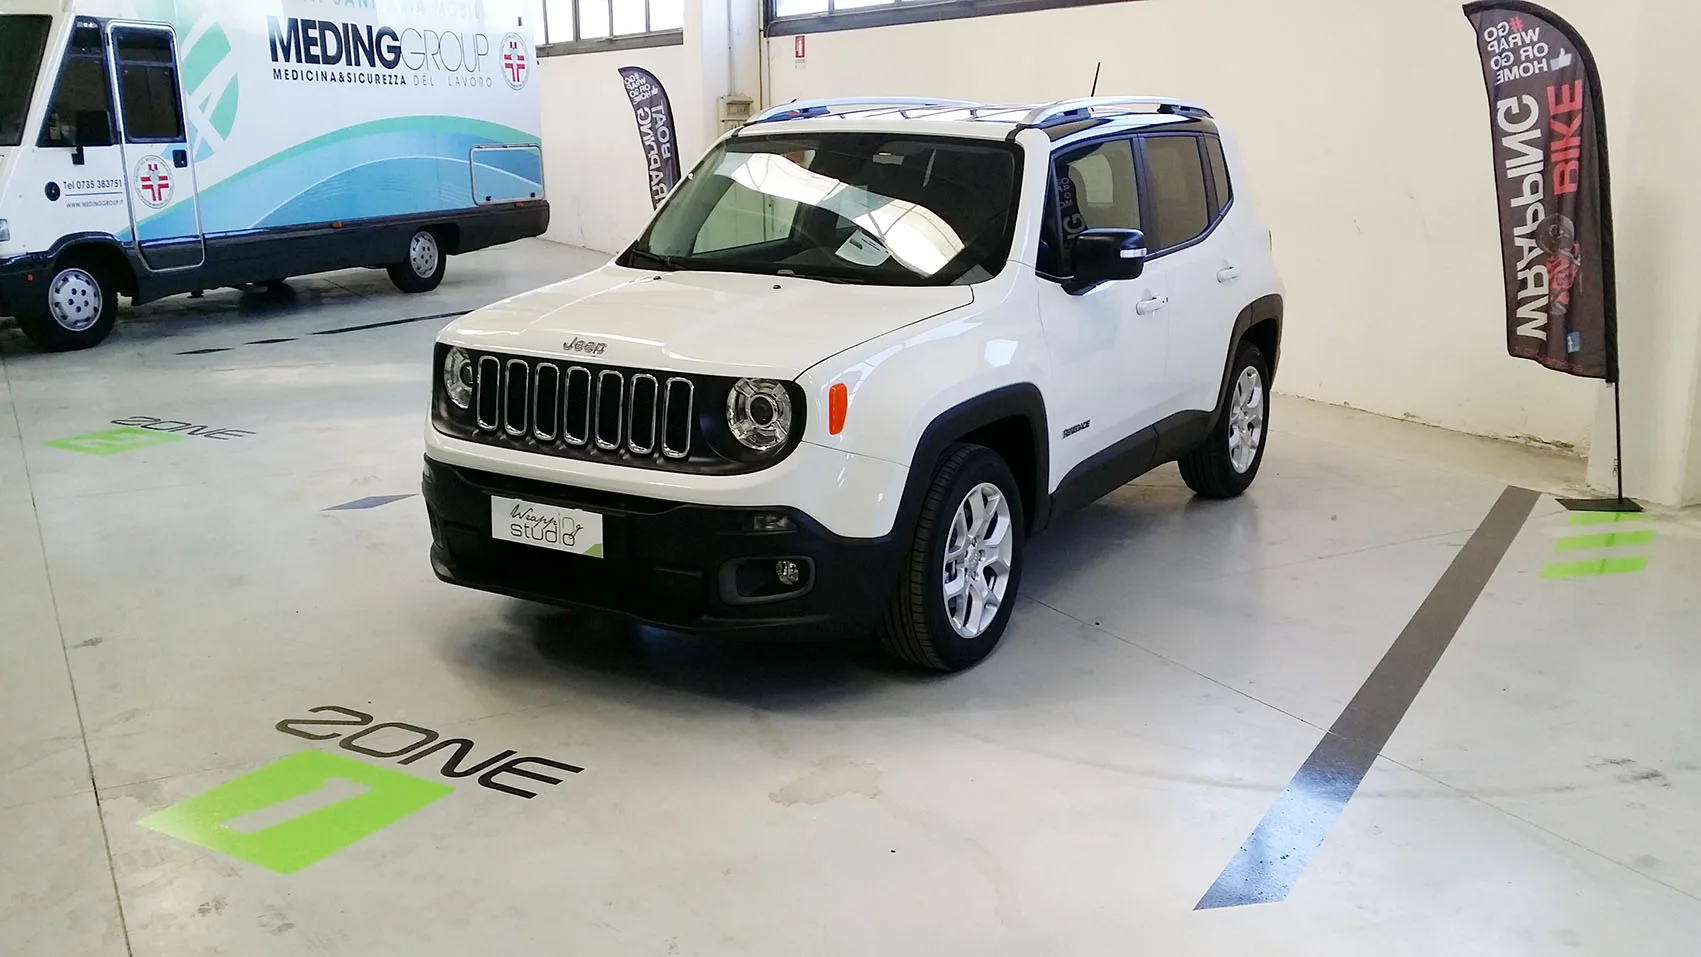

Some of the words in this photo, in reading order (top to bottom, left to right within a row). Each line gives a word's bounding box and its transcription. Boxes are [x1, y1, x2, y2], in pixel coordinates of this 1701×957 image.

[273, 68, 407, 86] MEDICINA&SICUREZZA
[413, 74, 435, 87] DEL
[448, 77, 493, 88] LAVORO
[63, 181, 75, 190] Tel
[76, 180, 95, 190] 0735
[96, 179, 123, 189] 383751
[563, 337, 607, 355] Jeep
[110, 416, 257, 440] ZONE
[510, 523, 576, 547] studio
[276, 706, 585, 799] ZONE
[218, 776, 373, 834] 1
